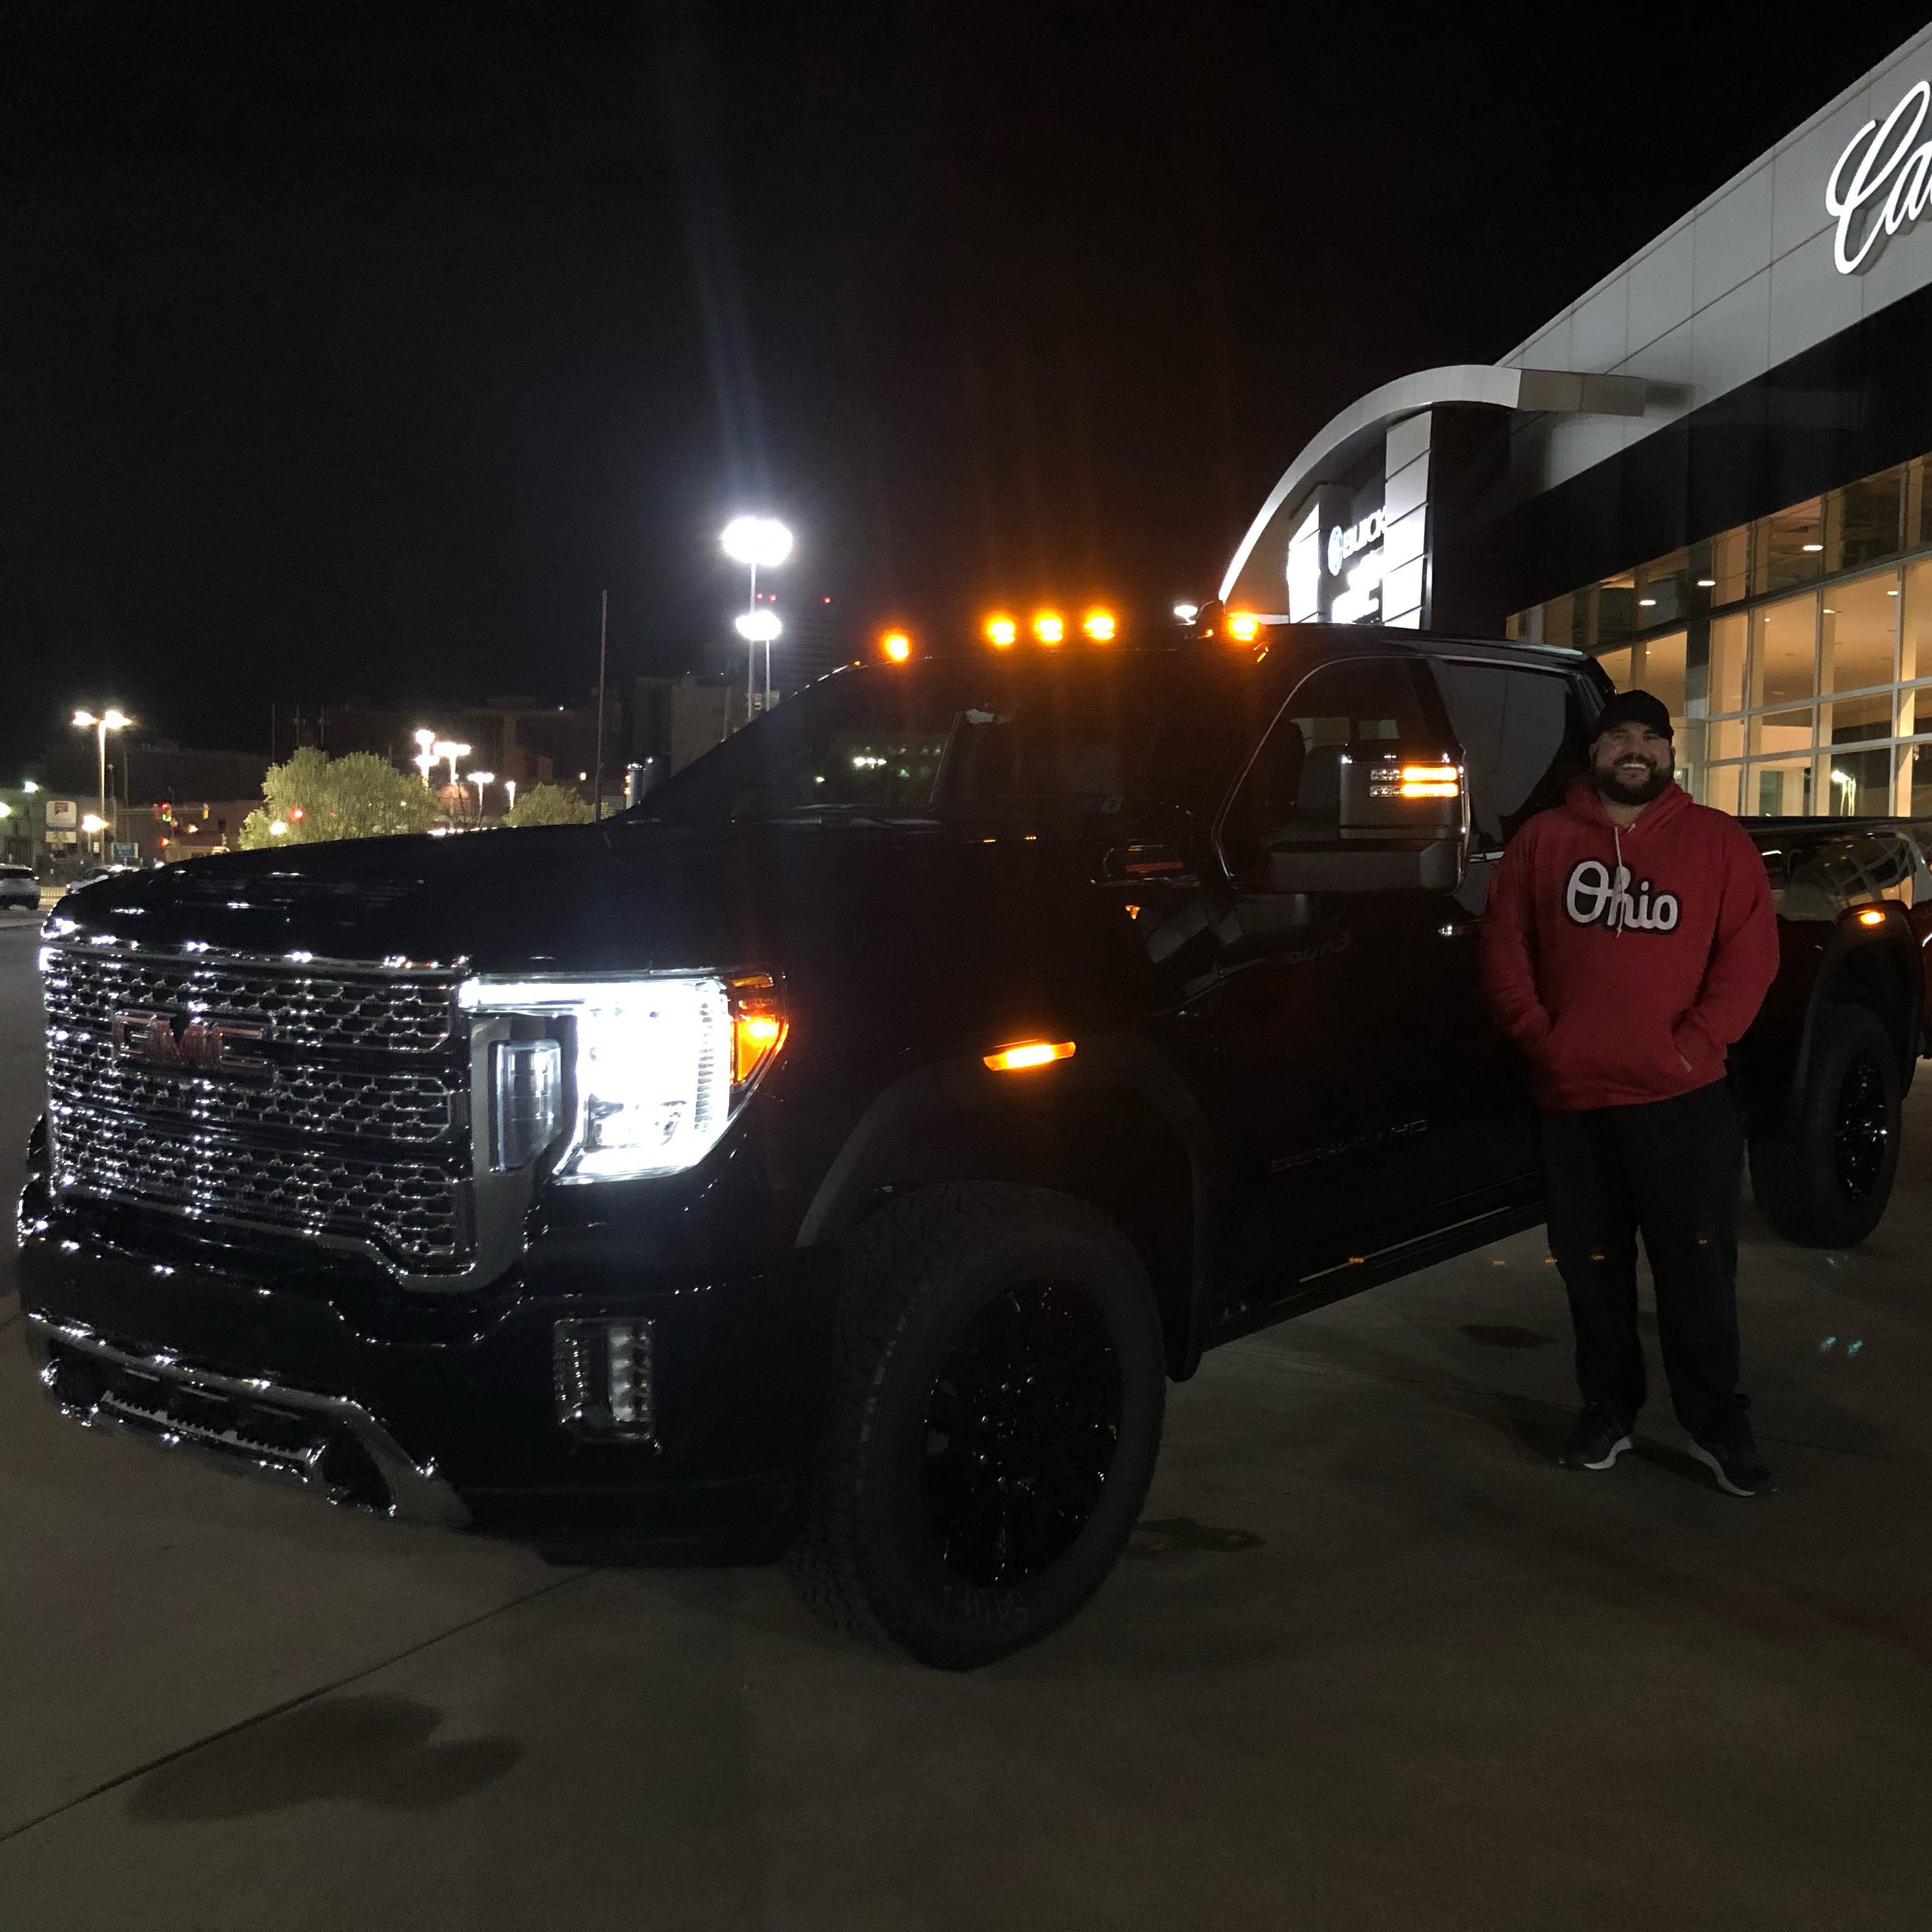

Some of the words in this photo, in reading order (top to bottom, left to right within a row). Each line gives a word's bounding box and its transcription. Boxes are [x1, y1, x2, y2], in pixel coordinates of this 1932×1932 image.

[1825, 80, 1932, 275] Ca
[1567, 860, 1678, 930] Ohio
[112, 1014, 268, 1070] GMC
